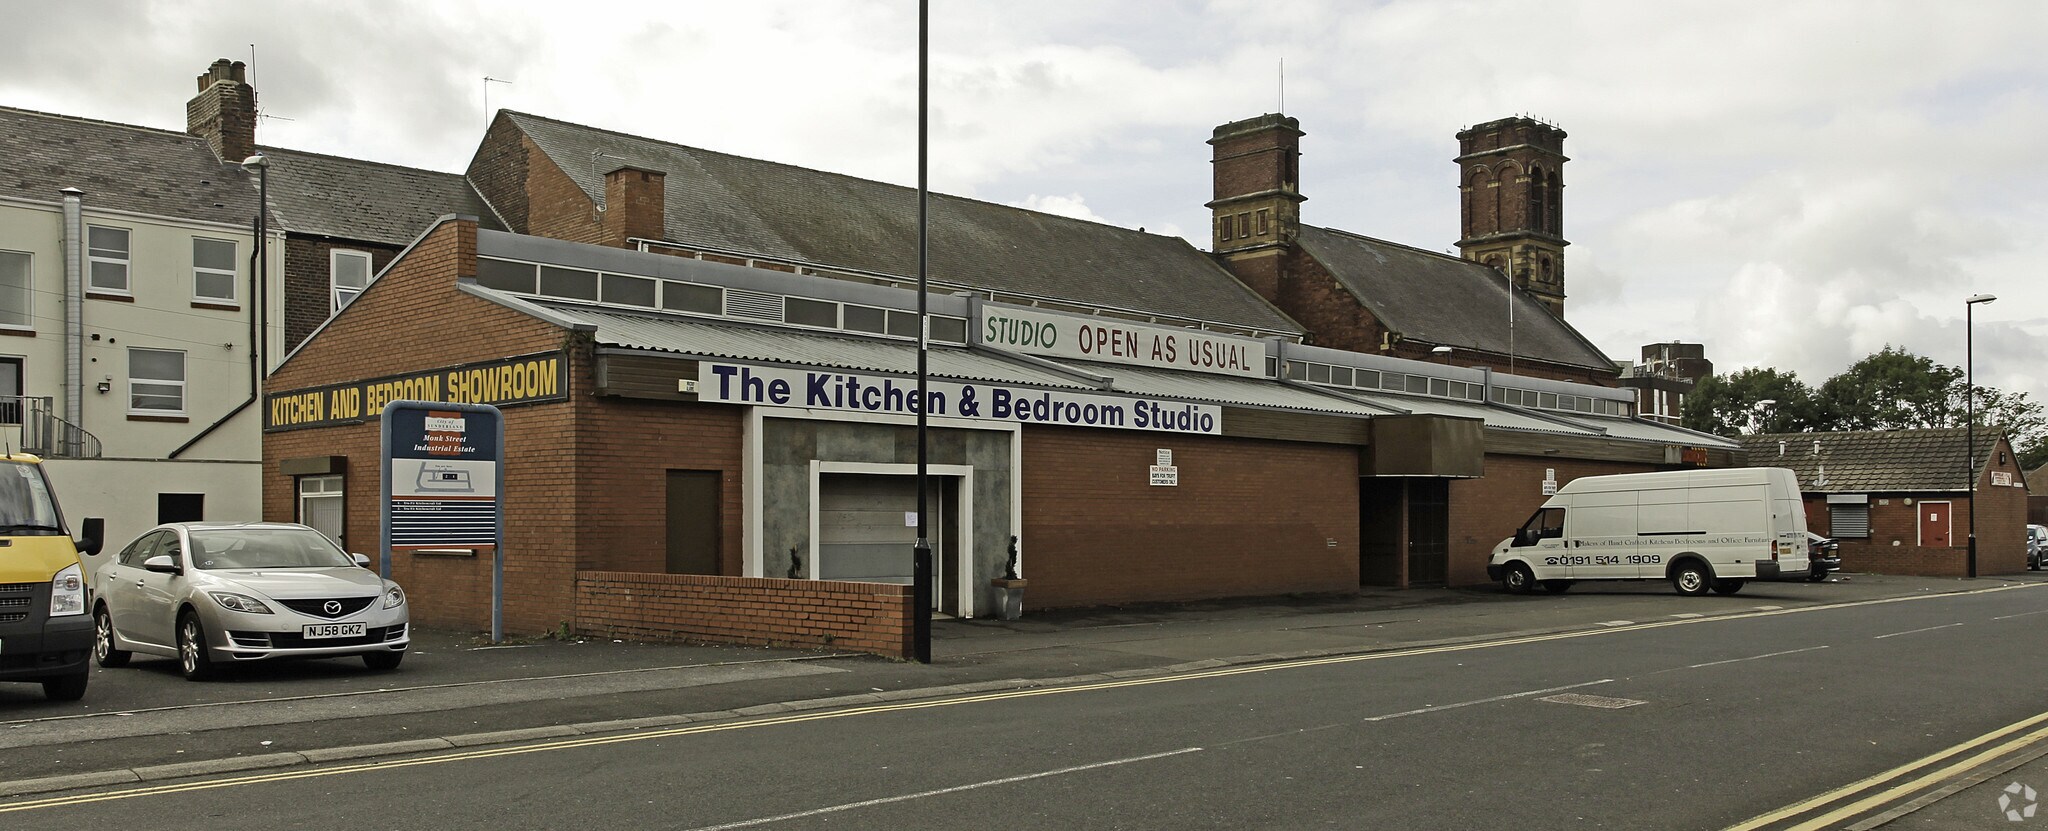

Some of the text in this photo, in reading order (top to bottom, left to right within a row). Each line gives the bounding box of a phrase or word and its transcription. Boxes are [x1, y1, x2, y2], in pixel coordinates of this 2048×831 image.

[985, 316, 1250, 371] STUDIO OPEN AS USUAL
[271, 391, 324, 426] KITCHEN
[330, 387, 360, 420] AND
[448, 359, 557, 404] SHOWROOM
[712, 365, 1214, 432] The Kitchen & Bedroom Studio
[422, 434, 467, 443] Monk Street
[413, 444, 476, 453] Industrial Estate
[1560, 555, 1660, 564] 0191 514 1909
[309, 624, 361, 636] NJ58 GKZ
